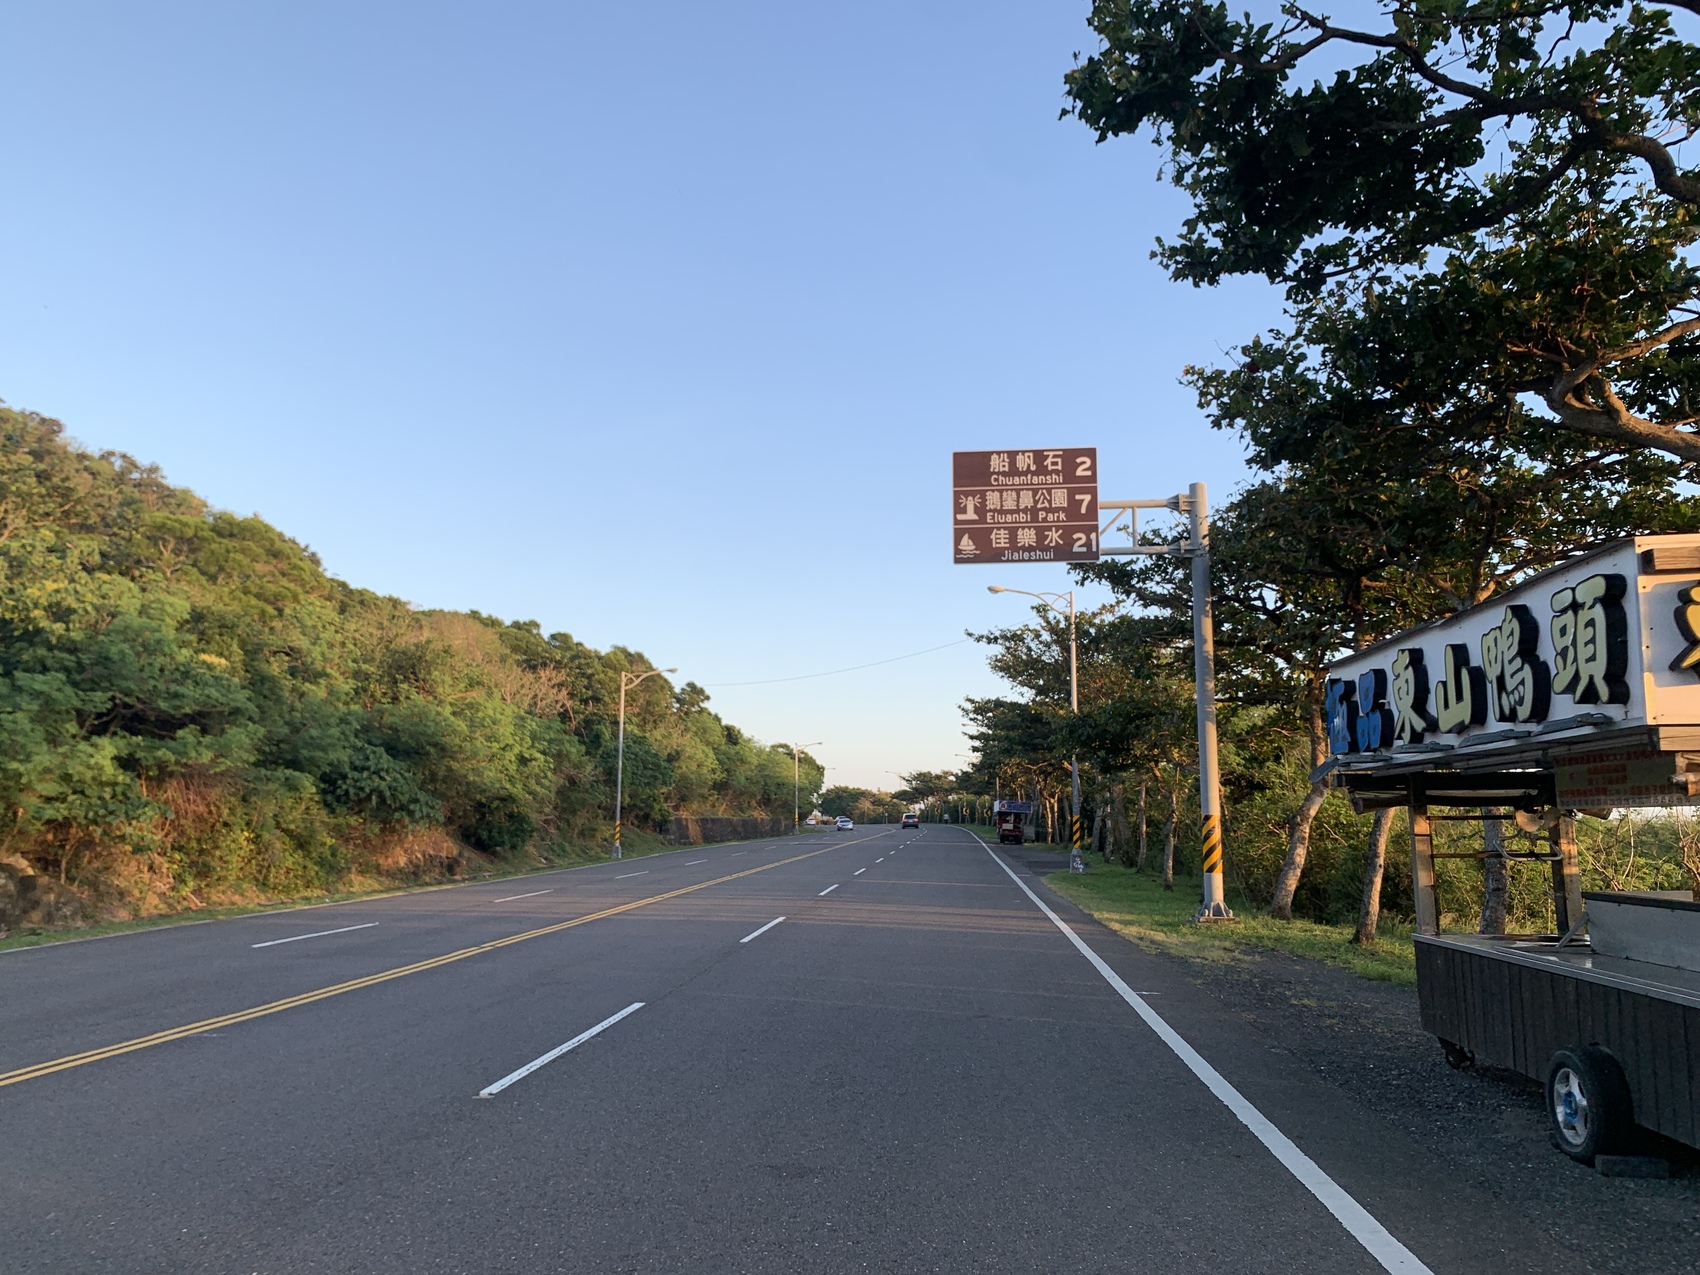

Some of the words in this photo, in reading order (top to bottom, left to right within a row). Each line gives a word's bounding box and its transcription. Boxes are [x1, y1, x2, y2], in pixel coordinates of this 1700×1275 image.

[990, 451, 1063, 472] 船帆石
[1075, 457, 1092, 476] 2
[991, 473, 1063, 485] Chuanfanshi
[985, 489, 1068, 510] 鵝鑾鼻公園
[1075, 494, 1091, 514] 7
[987, 512, 1031, 523] Eluanbi
[1038, 511, 1067, 522] Park
[990, 527, 1064, 548] 佳樂水
[1072, 532, 1097, 552] 21
[1001, 549, 1054, 561] Jialeshui
